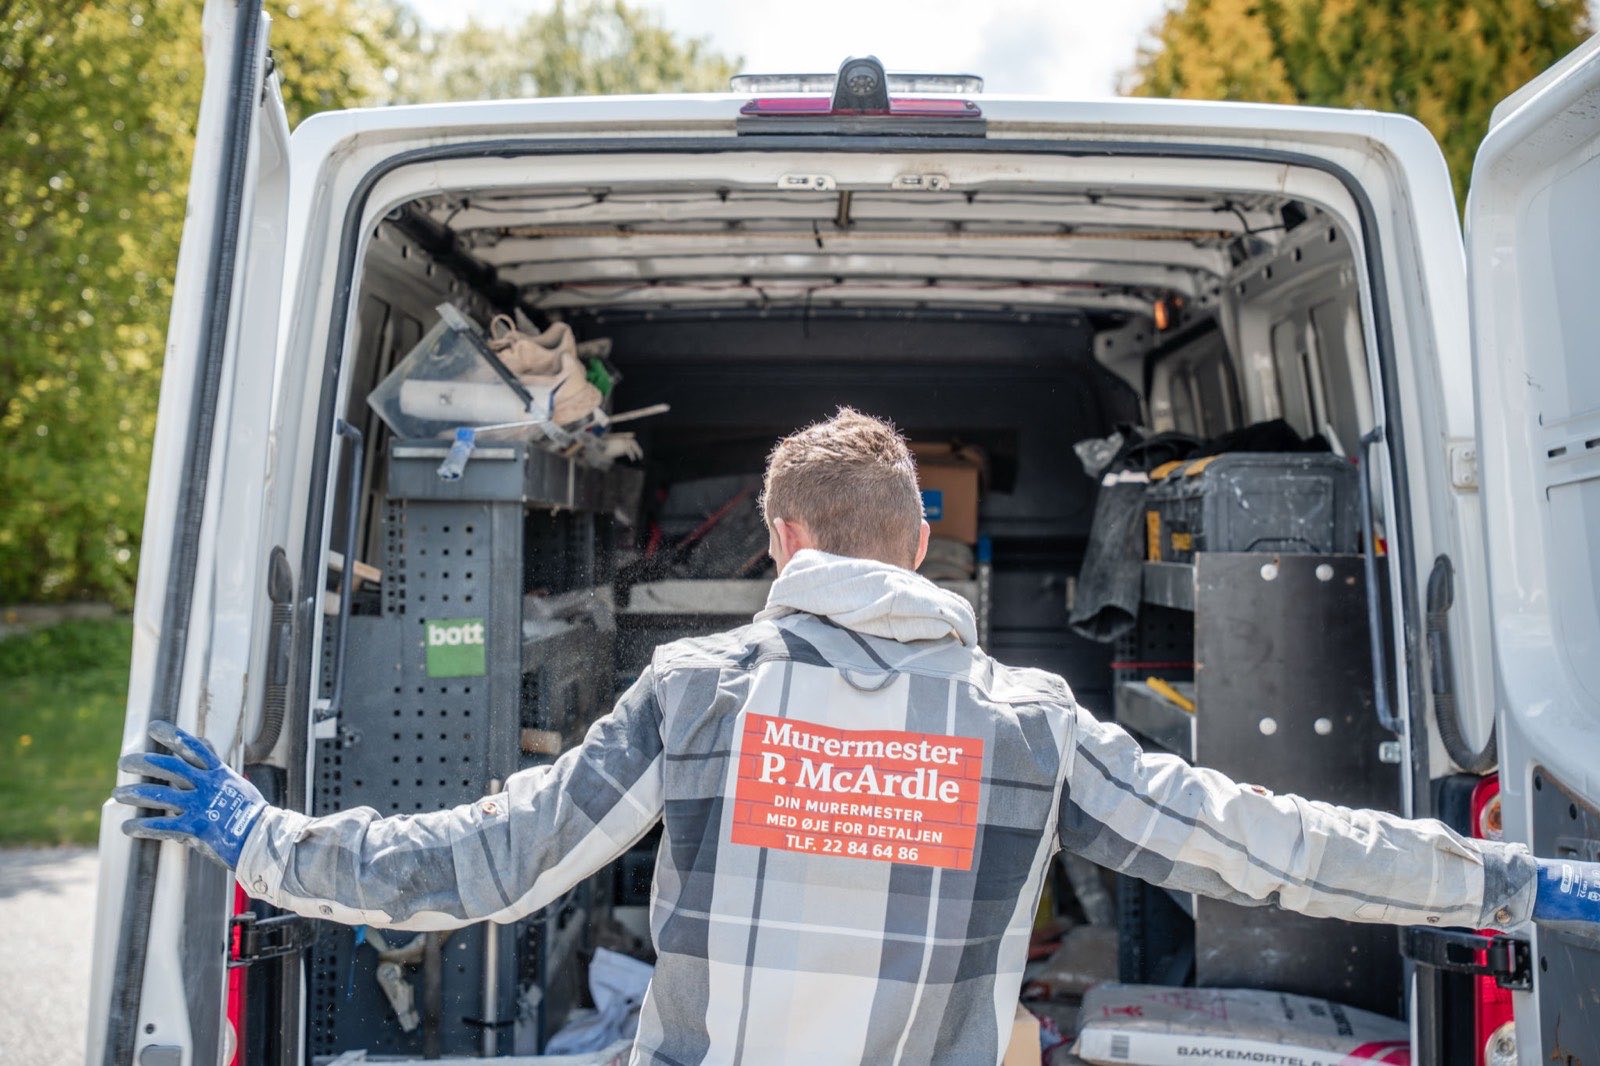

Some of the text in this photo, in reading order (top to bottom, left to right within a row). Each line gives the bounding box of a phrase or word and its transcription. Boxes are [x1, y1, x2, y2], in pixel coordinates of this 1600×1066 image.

[428, 622, 485, 646] bott
[761, 720, 963, 766] Murermester
[758, 752, 961, 804] P. McArdle
[773, 794, 924, 823] DIN MURERMESTER
[766, 812, 943, 844] MED ØJE FOR DETALJEN
[785, 834, 919, 862] TLF. 22 84 64 86
[1176, 1045, 1306, 1066] BAKKEMØRTEL
